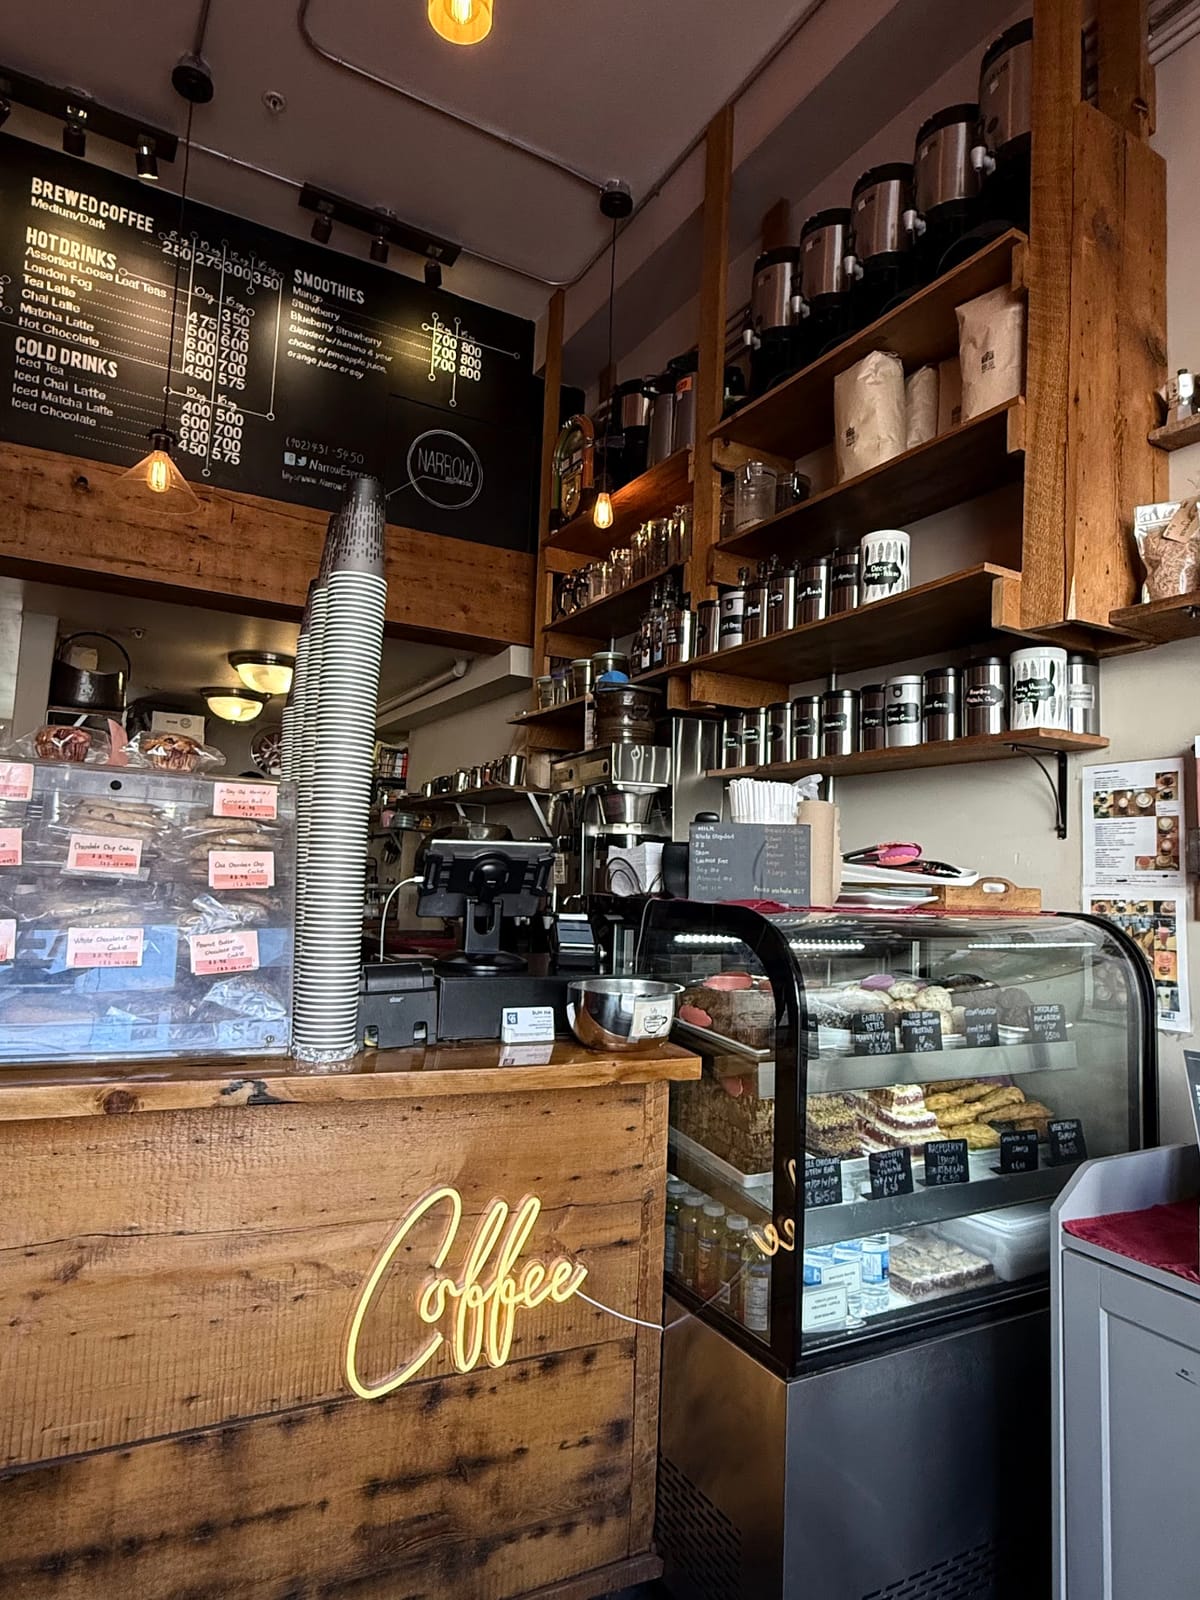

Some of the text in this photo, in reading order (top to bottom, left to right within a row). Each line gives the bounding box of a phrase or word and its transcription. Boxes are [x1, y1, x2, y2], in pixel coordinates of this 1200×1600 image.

[31, 177, 154, 233] BREWED COFFEE
[31, 196, 106, 230] Medium/Dark
[26, 226, 117, 270] HOT DRINKS
[22, 273, 44, 289] Tea
[47, 280, 77, 298] Latte
[24, 260, 67, 282] London
[70, 274, 93, 292] Fog
[25, 246, 76, 270] Assorted
[79, 262, 113, 282] Loose
[115, 273, 140, 291] Leaf
[141, 281, 167, 298] Teas
[293, 268, 365, 305] SMOOTHIES
[22, 288, 48, 306] Chai
[51, 297, 81, 313] Latte
[291, 298, 341, 321] Strawberry
[292, 285, 324, 304] Mango
[18, 316, 40, 331] Hot
[42, 323, 100, 348] Chocolate
[19, 302, 63, 322] Matcha
[65, 316, 95, 332] Latte
[290, 310, 334, 333] Blueberry
[335, 325, 383, 348] Strawberry
[15, 336, 118, 379] COLD DRINKS
[288, 324, 325, 341] Blended
[336, 339, 366, 355] banana
[375, 352, 393, 362] your
[288, 338, 316, 352] choice
[317, 346, 328, 355] of
[327, 350, 366, 367] pineapple
[16, 355, 41, 370] Iced
[44, 362, 64, 376] Tea
[287, 350, 365, 380] orange juice or soy
[13, 383, 39, 398] Iced
[41, 390, 83, 409] Matcha
[86, 402, 114, 417] Latte
[14, 370, 40, 384] Iced
[43, 376, 69, 392] Chai
[74, 383, 106, 401] Latte
[11, 397, 37, 412] Iced
[39, 404, 97, 427] Chocolate
[418, 447, 475, 482] NARROW
[345, 1186, 589, 1400] Coffee
